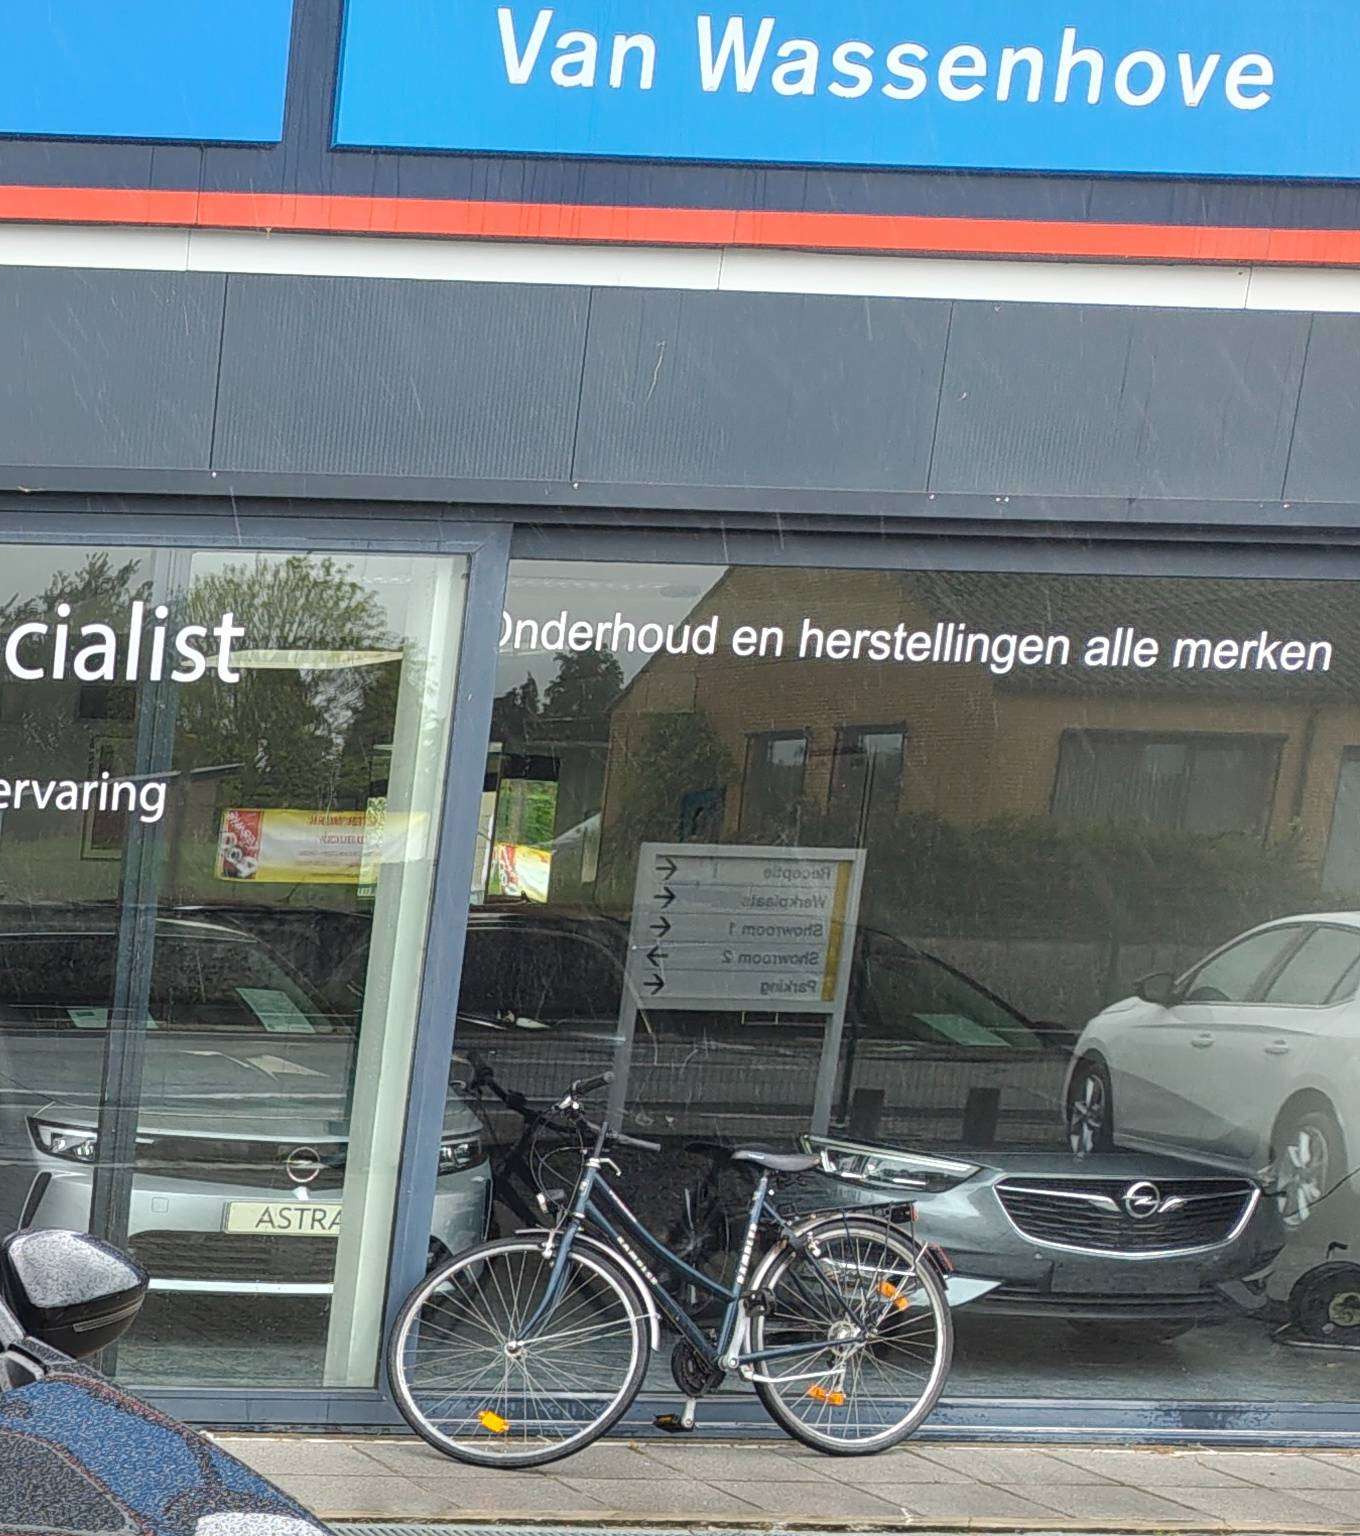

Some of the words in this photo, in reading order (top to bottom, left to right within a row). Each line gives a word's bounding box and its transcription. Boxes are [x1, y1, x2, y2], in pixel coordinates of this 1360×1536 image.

[497, 7, 656, 90] Van
[697, 14, 1275, 111] Wassenhove
[731, 625, 784, 657] en
[798, 617, 1071, 675] herstellingen
[1083, 626, 1160, 668] alle
[1172, 630, 1333, 671] merken
[255, 1206, 342, 1231] ASTRA
